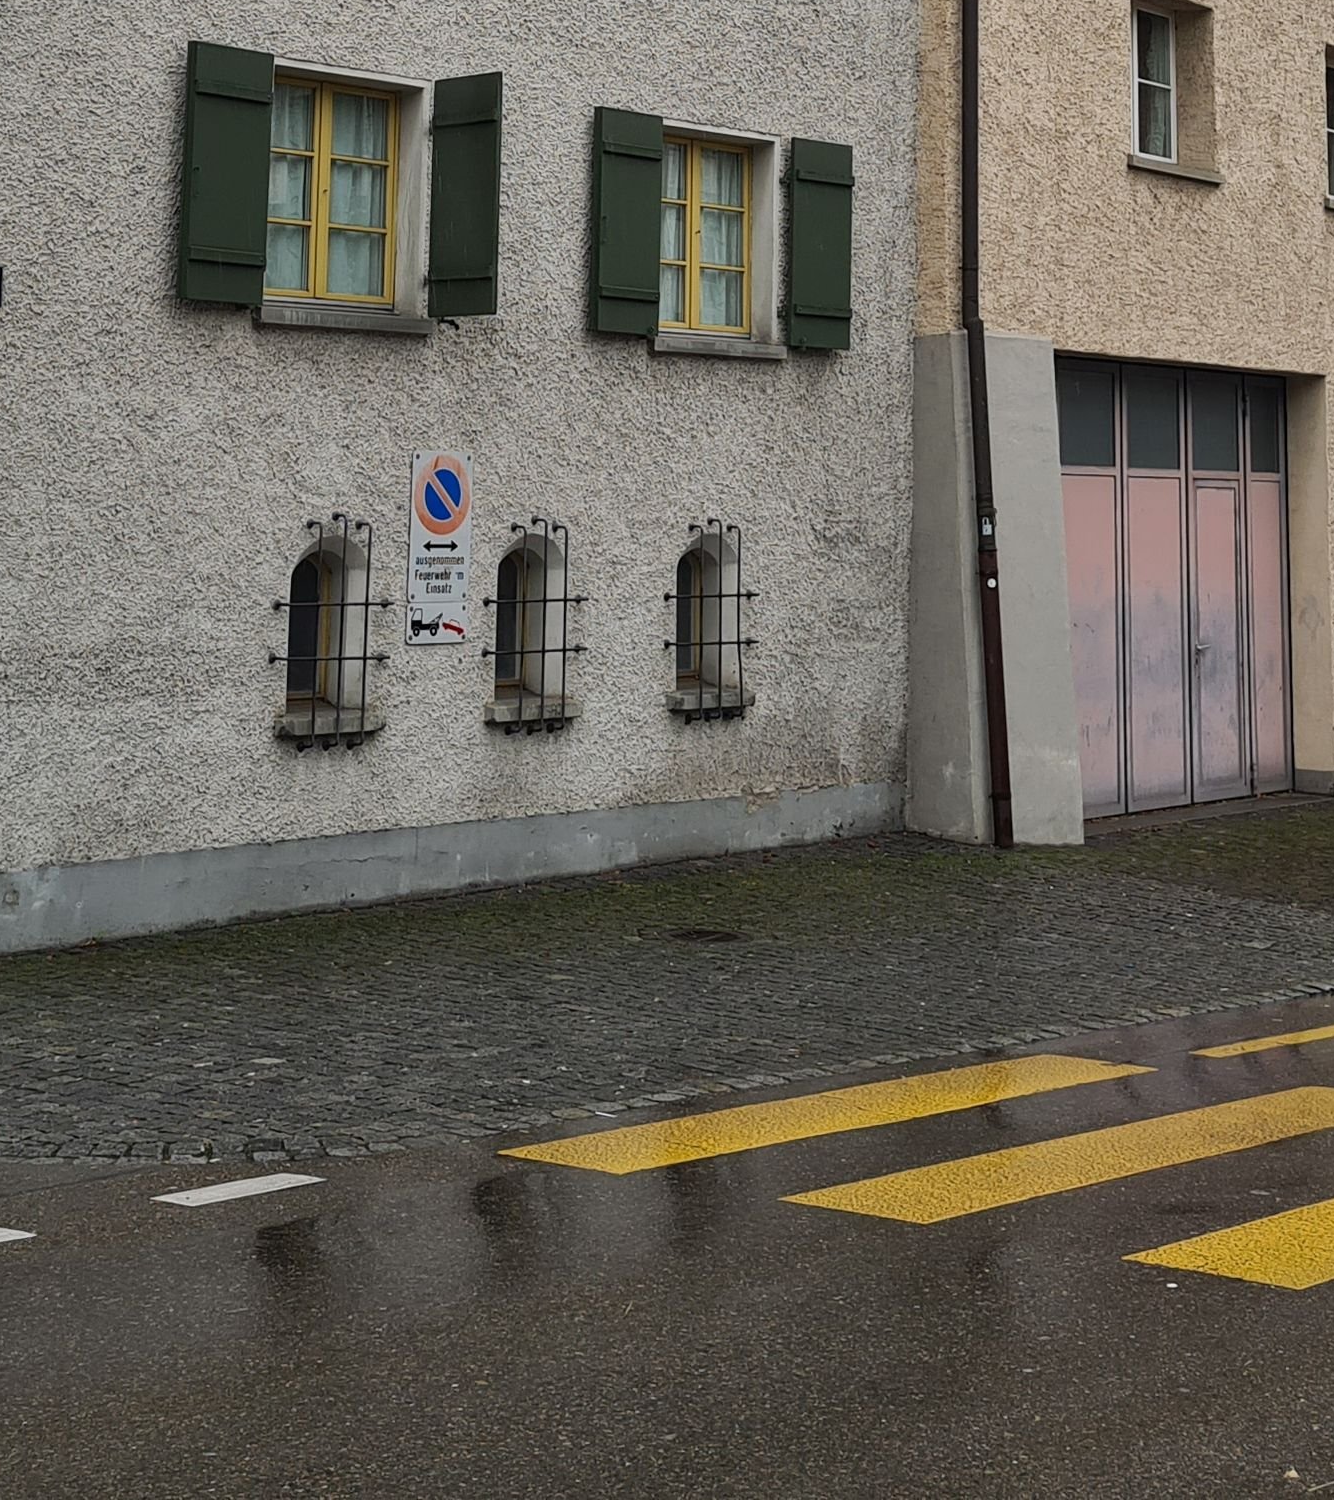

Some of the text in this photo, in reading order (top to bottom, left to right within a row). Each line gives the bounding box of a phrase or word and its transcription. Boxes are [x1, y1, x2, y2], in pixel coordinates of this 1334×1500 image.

[415, 556, 465, 568] ausgenommen
[414, 569, 452, 580] Feuerwehr
[426, 582, 453, 594] Einsatz
